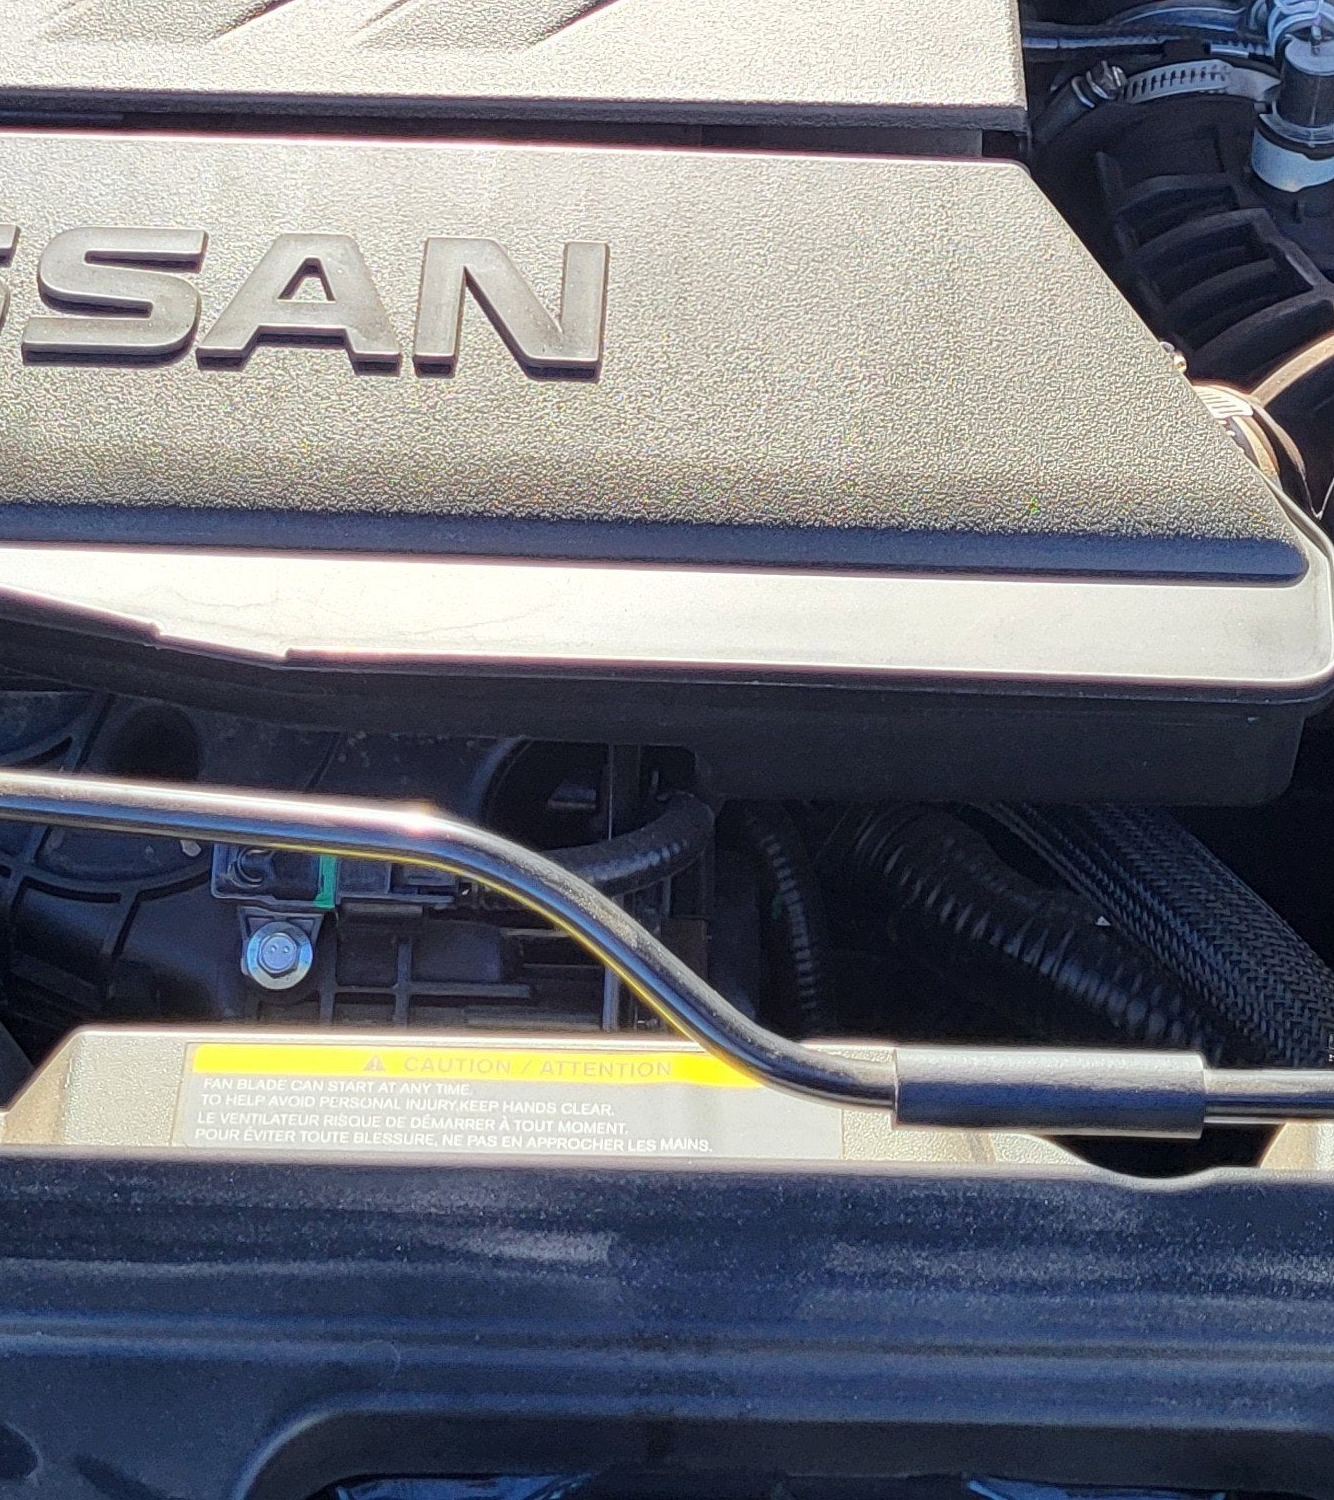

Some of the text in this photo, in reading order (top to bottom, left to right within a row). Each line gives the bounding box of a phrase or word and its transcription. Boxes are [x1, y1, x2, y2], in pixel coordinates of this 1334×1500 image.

[404, 1055, 511, 1075] CAUTION
[540, 1059, 672, 1079] ATTENTION
[203, 1077, 474, 1097] FAN BLADE CAN START AT ANY TIME.
[201, 1093, 222, 1106] TO
[225, 1094, 265, 1107] HELP
[268, 1095, 316, 1108] AVOID
[319, 1097, 400, 1111] PERSONAL
[502, 1100, 558, 1114] HANDS
[560, 1102, 615, 1117] CLEAR.
[197, 1111, 629, 1136] LE VENTILATEUR RISQUE DE DÉMARRER À TOUT MOMENT.
[195, 1125, 713, 1153] POUR ÉVITER TOUTE BLESSURE, NE PAS EN APPROCHER LES MAINS.
